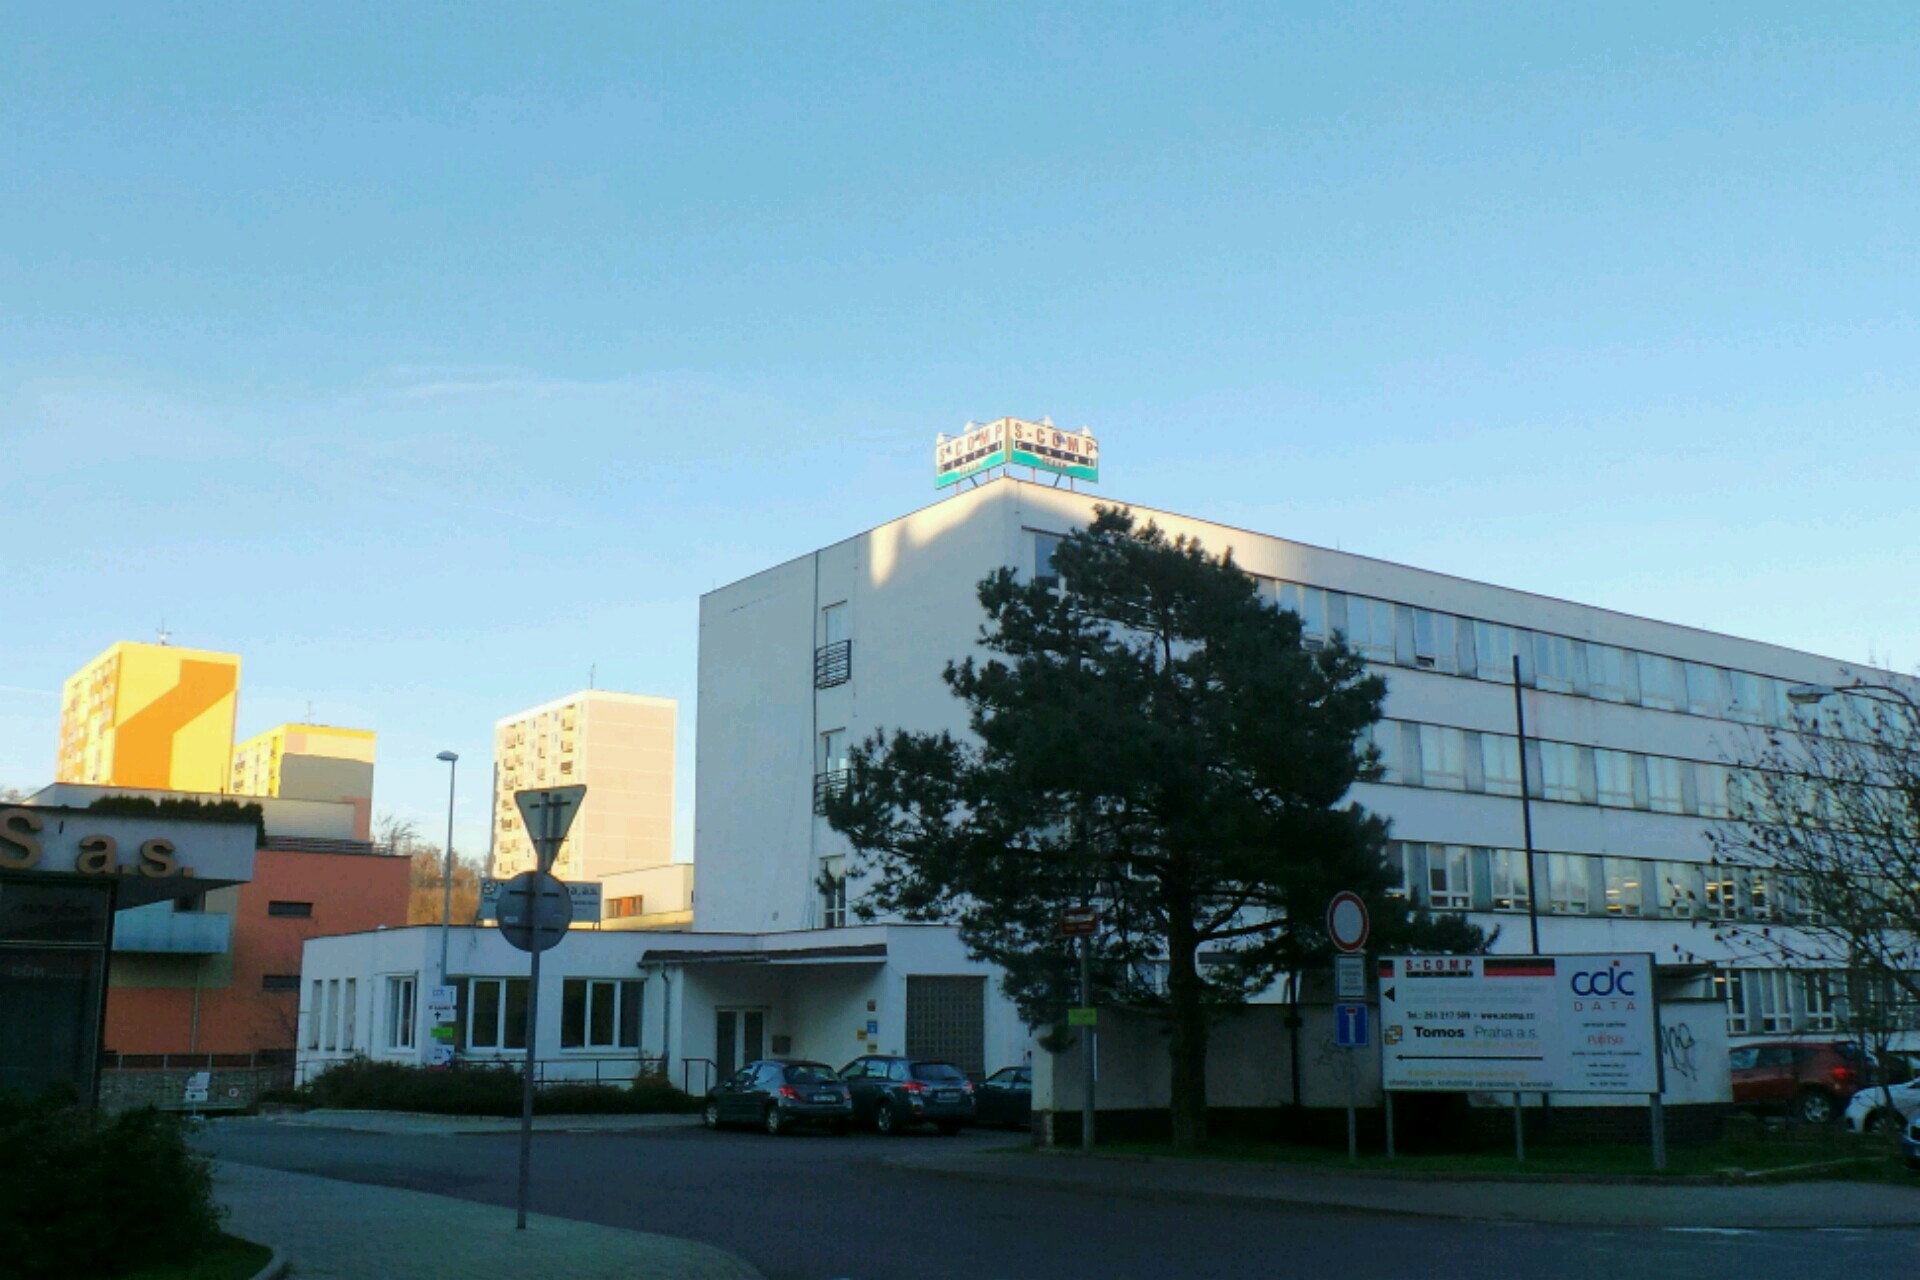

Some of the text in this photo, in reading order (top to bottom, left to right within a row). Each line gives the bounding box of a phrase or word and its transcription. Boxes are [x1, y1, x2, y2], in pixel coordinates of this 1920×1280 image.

[1014, 422, 1094, 456] S-COMP
[77, 833, 194, 878] a.s.
[1405, 959, 1473, 970] S-COMP
[1574, 1001, 1637, 1012] DATA
[1413, 1026, 1465, 1038] Tomos
[1473, 1025, 1513, 1038] Praha
